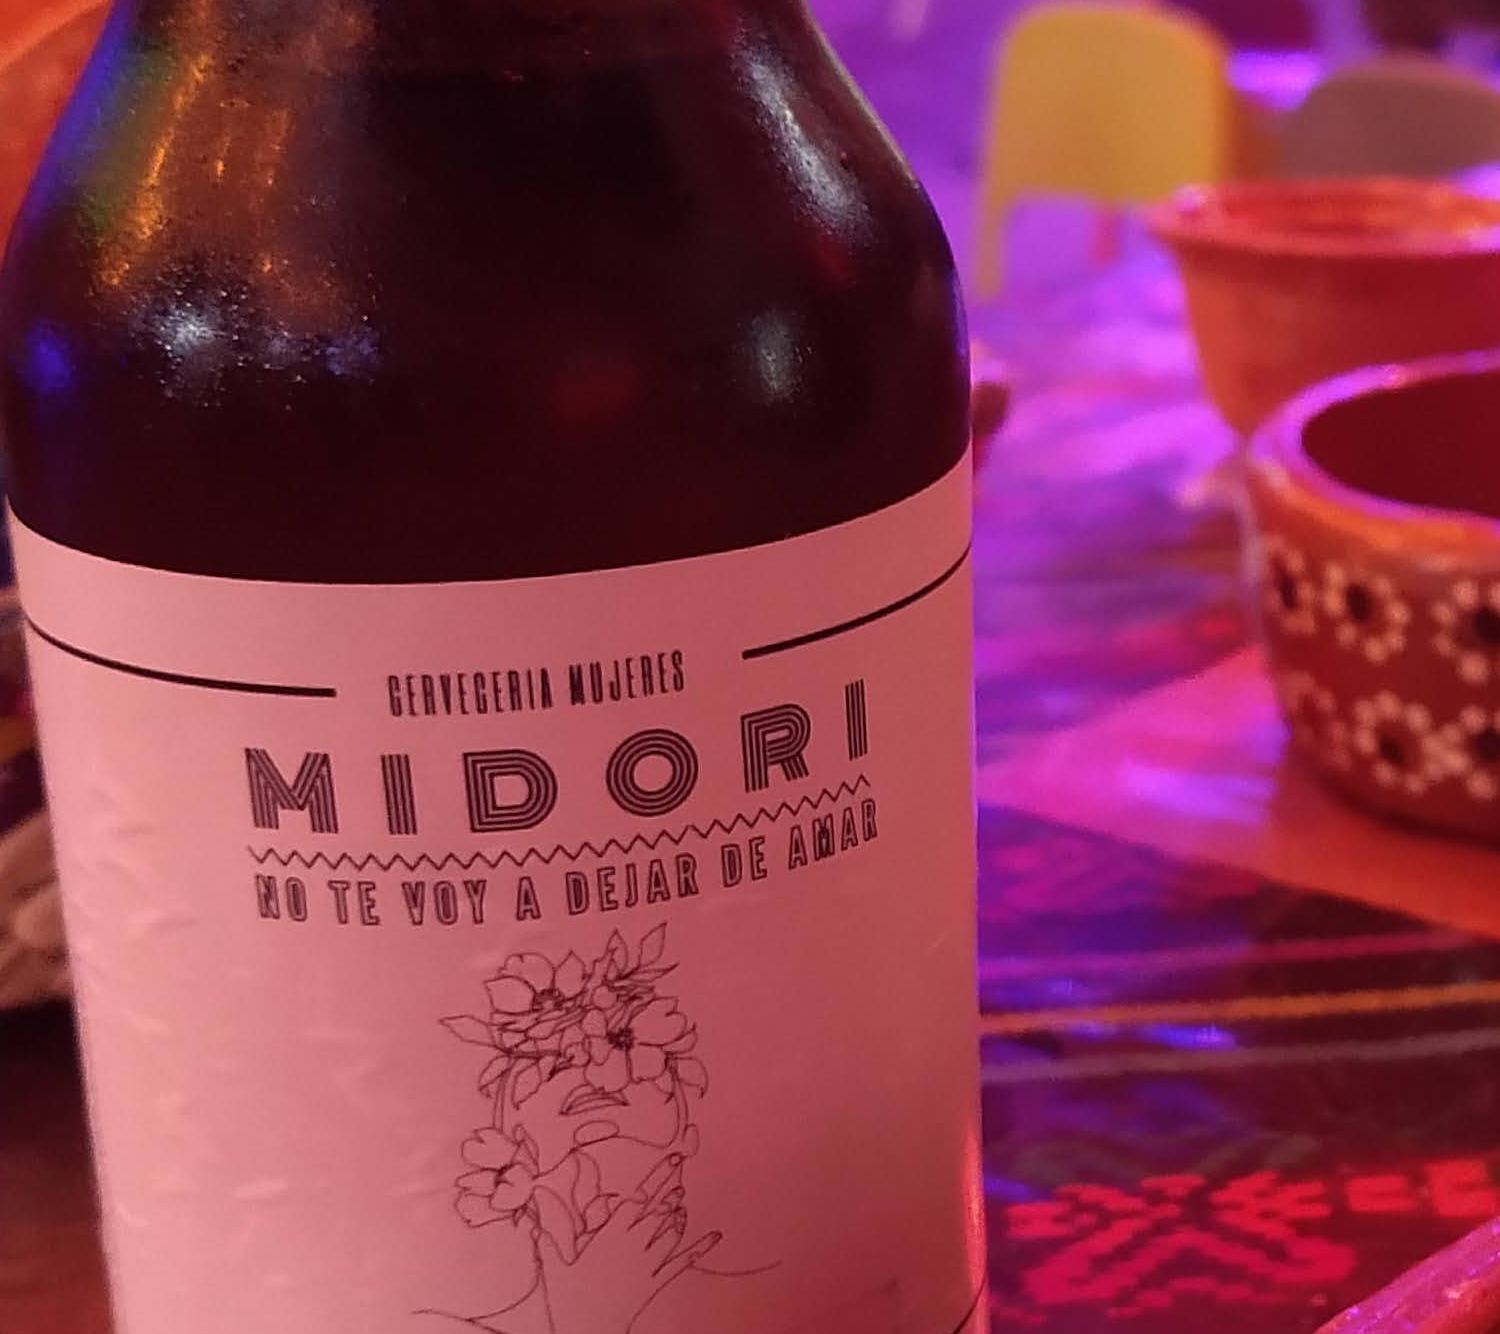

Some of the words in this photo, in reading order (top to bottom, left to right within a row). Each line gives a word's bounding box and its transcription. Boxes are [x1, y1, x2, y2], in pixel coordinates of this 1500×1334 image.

[387, 667, 554, 718] CERVECERIA
[568, 649, 685, 706] MUJERES
[245, 679, 868, 835] MIDORI
[255, 874, 308, 923] NO
[328, 879, 381, 926] TE
[402, 879, 487, 927] VOY
[515, 875, 542, 921] A
[565, 852, 700, 915] DEJAR
[721, 835, 768, 888] DE
[788, 798, 878, 870] AMAR
